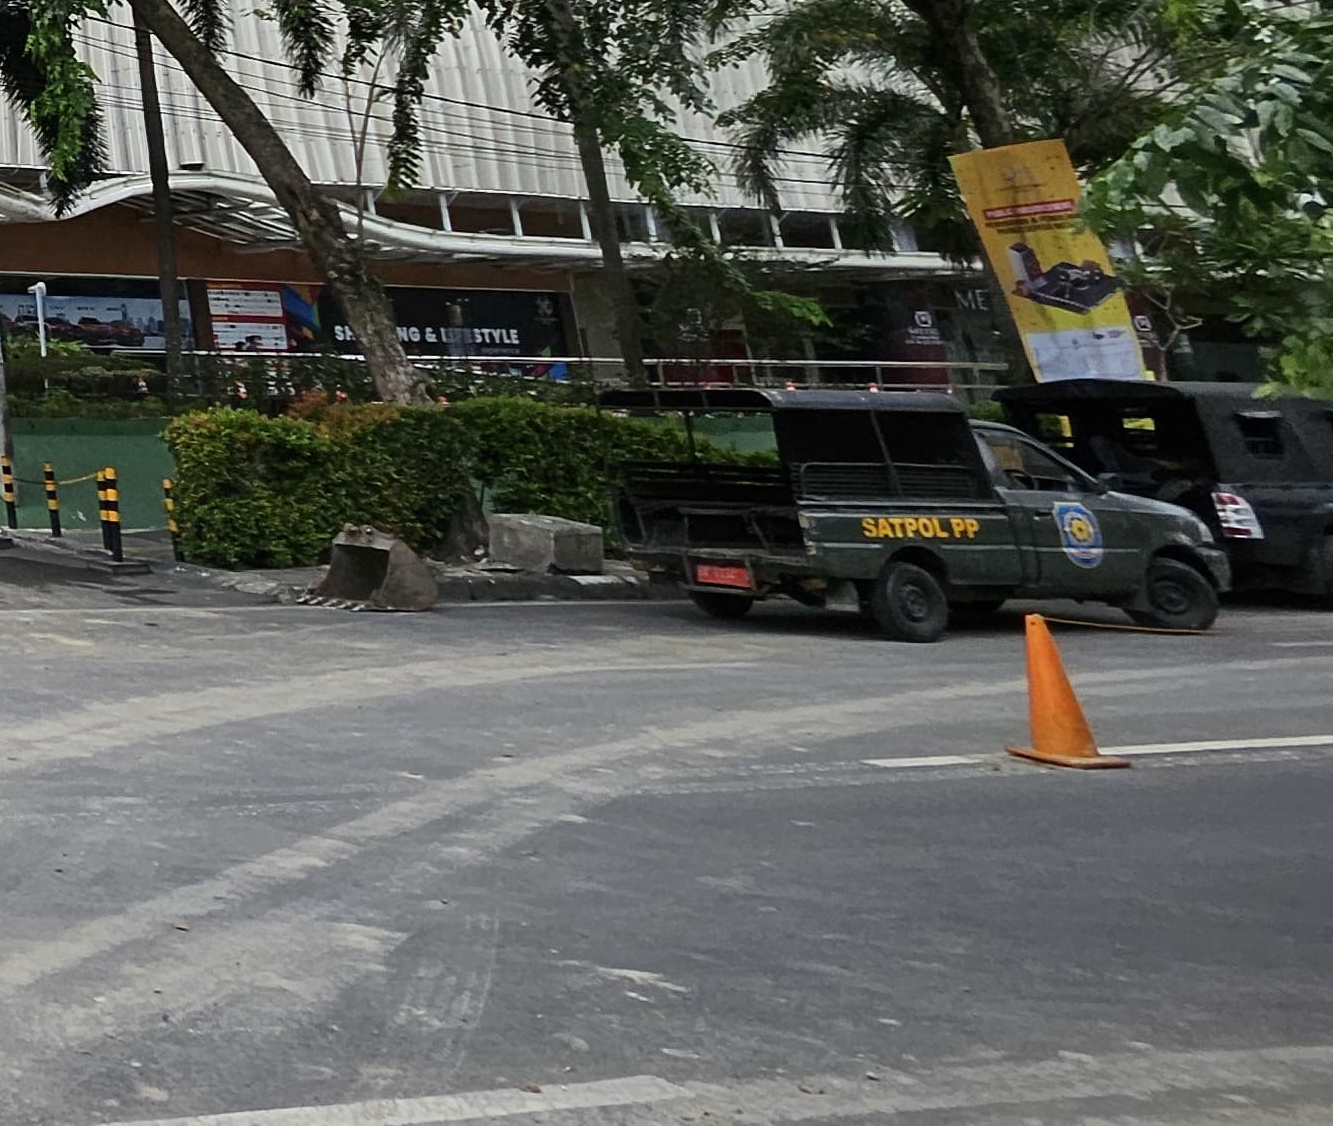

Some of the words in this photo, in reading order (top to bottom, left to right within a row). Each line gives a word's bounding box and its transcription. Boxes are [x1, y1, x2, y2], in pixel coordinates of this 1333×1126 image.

[425, 327, 437, 342] &
[441, 327, 520, 345] LIFESTYLE
[861, 517, 949, 539] SATPOL
[949, 518, 981, 539] PP
